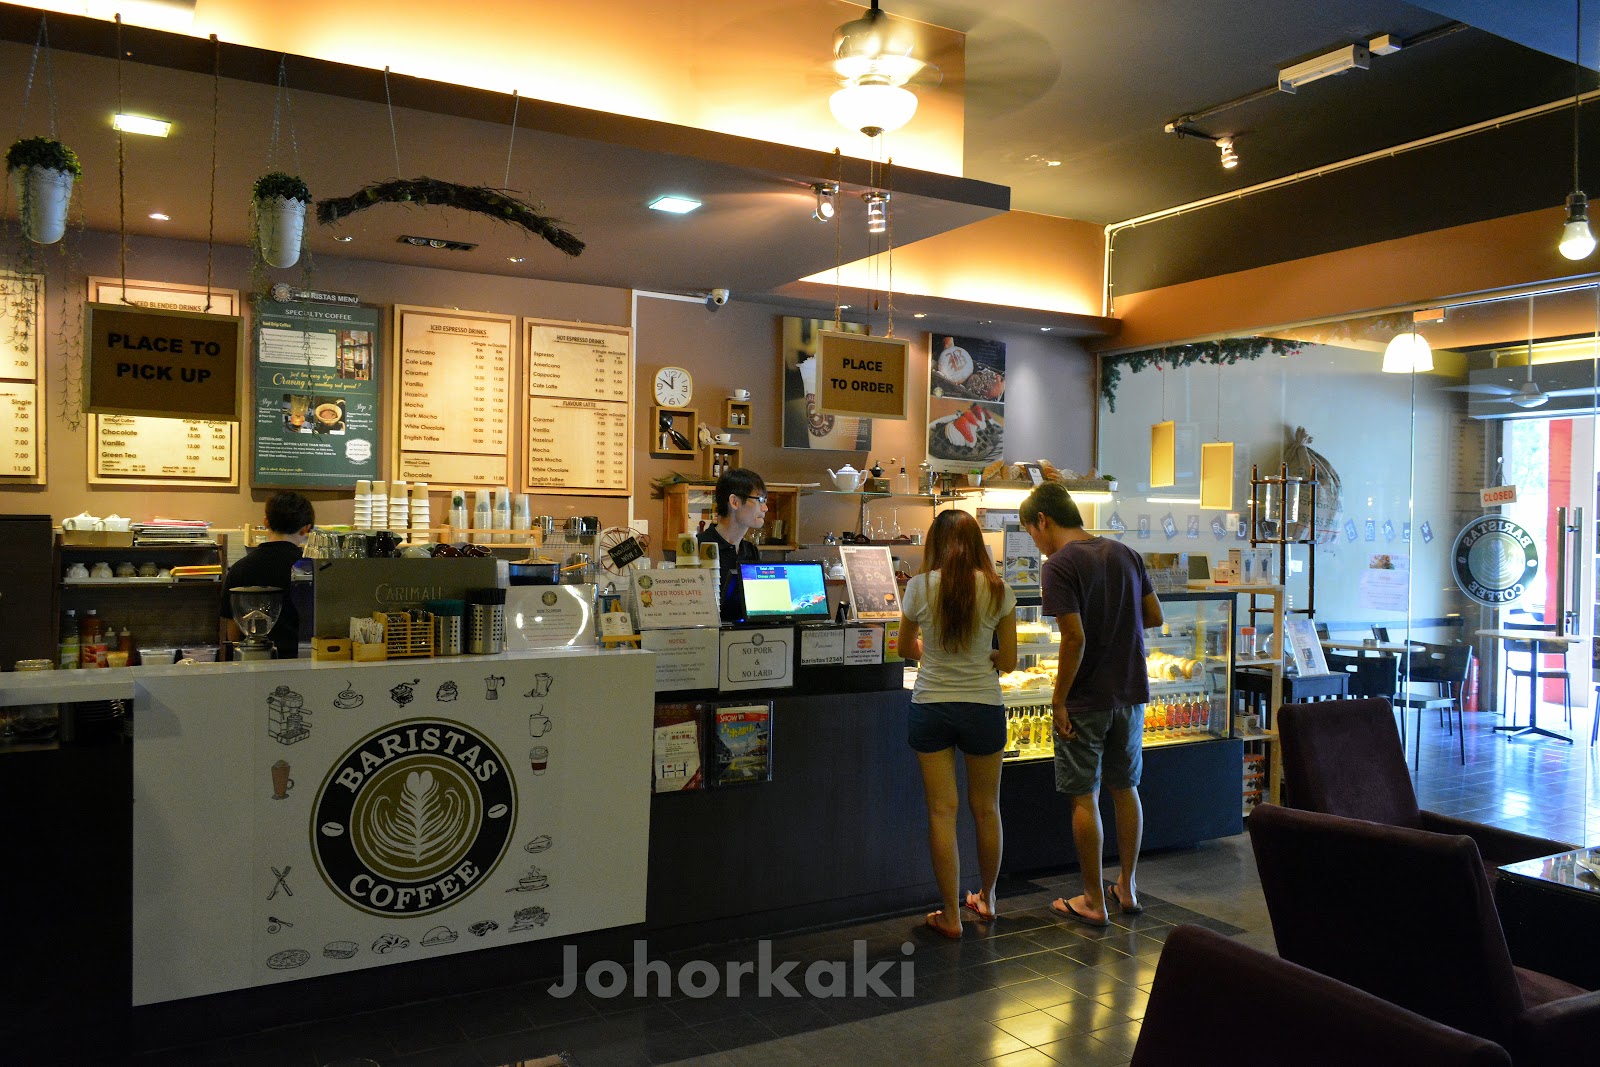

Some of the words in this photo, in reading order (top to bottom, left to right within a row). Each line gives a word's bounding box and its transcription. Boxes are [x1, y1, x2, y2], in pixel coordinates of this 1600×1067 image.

[325, 312, 352, 320] COFFEE
[108, 333, 183, 353] PLACE
[191, 340, 220, 356] TO
[843, 358, 882, 372] PLACE
[117, 363, 172, 381] PICK
[180, 367, 211, 383] UP
[831, 379, 847, 390] TO
[852, 380, 894, 393] ORDER
[1484, 490, 1514, 502] CLOSED
[742, 670, 751, 678] NO
[720, 714, 737, 723] SHOW
[336, 728, 499, 793] BARISTAS
[349, 859, 480, 910] COFFEE
